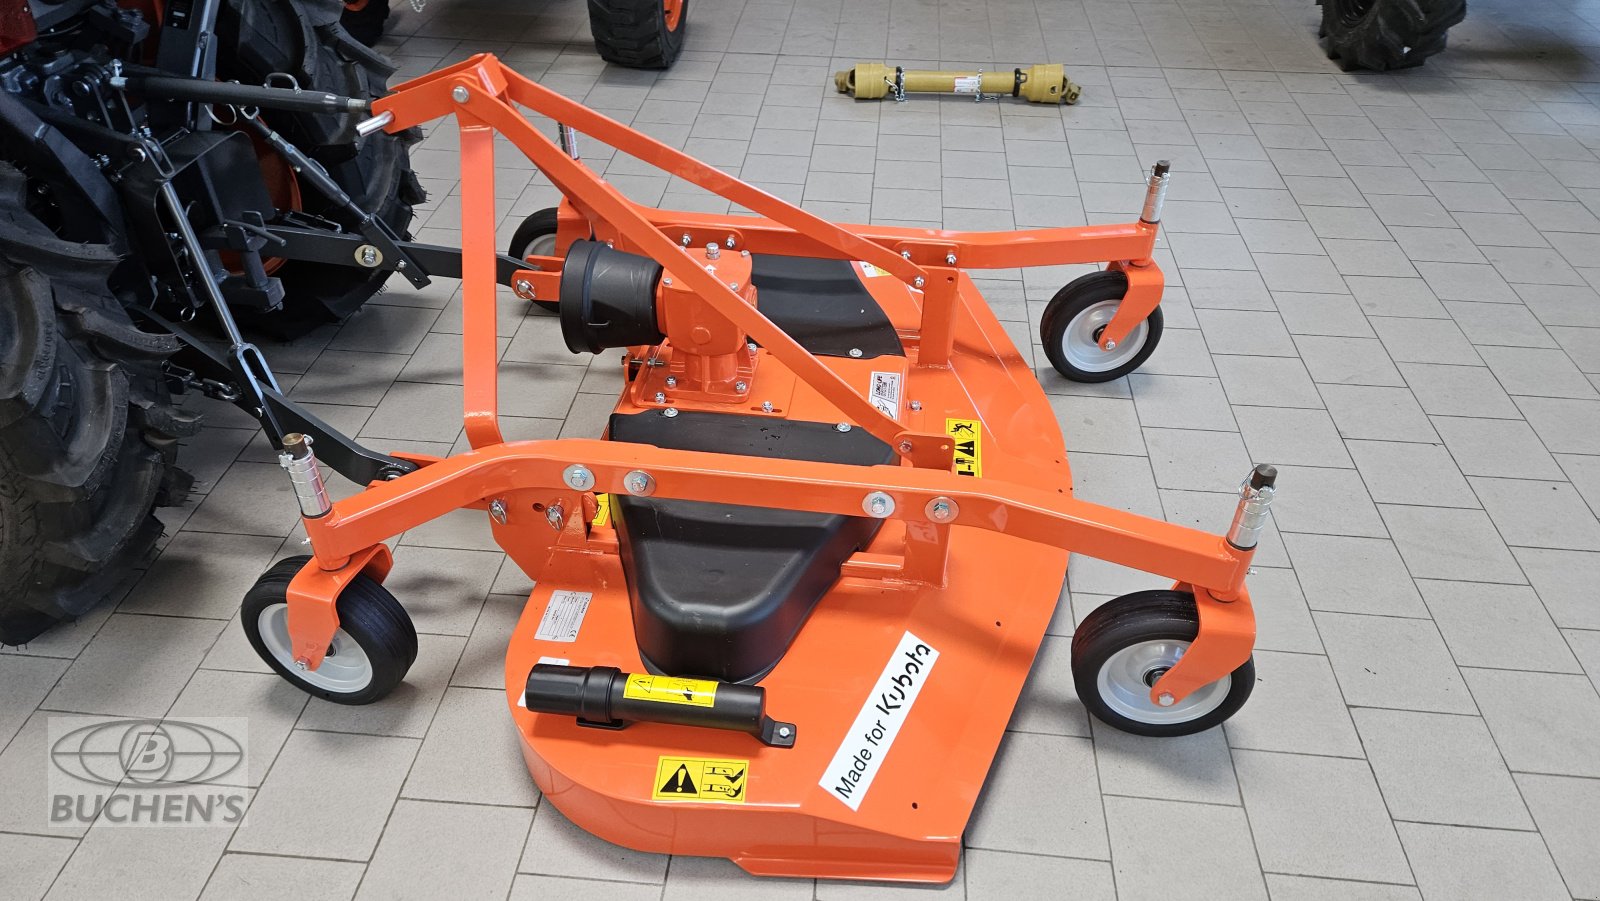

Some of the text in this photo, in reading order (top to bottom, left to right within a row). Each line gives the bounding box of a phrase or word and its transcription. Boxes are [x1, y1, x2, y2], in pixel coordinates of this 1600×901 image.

[834, 644, 931, 799] Made for Kubota
